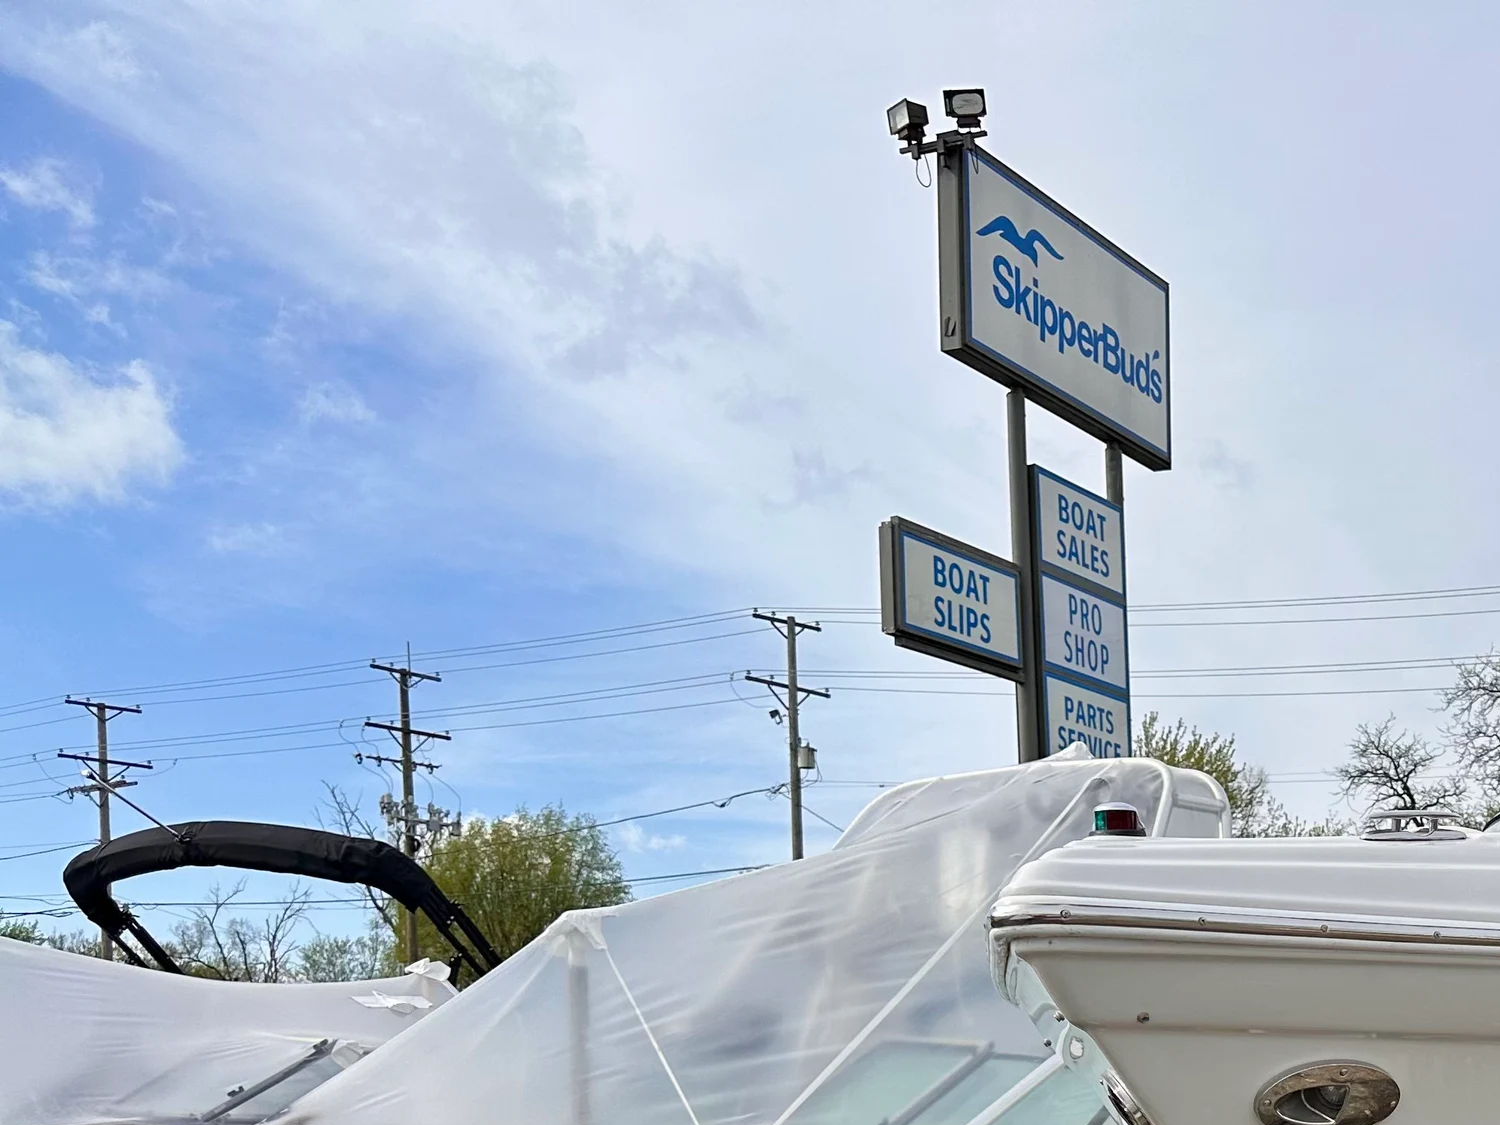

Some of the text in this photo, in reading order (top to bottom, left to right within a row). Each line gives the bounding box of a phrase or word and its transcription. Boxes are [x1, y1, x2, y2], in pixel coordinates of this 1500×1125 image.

[992, 254, 1163, 404] SkipperBud's
[1057, 494, 1107, 542] BOAT
[1056, 530, 1110, 578] SALES
[933, 555, 990, 605] BOAT
[934, 596, 991, 643] SLIPS
[1068, 593, 1103, 635] PRO
[1064, 631, 1110, 675] SHOP
[1064, 696, 1114, 735] PARTS
